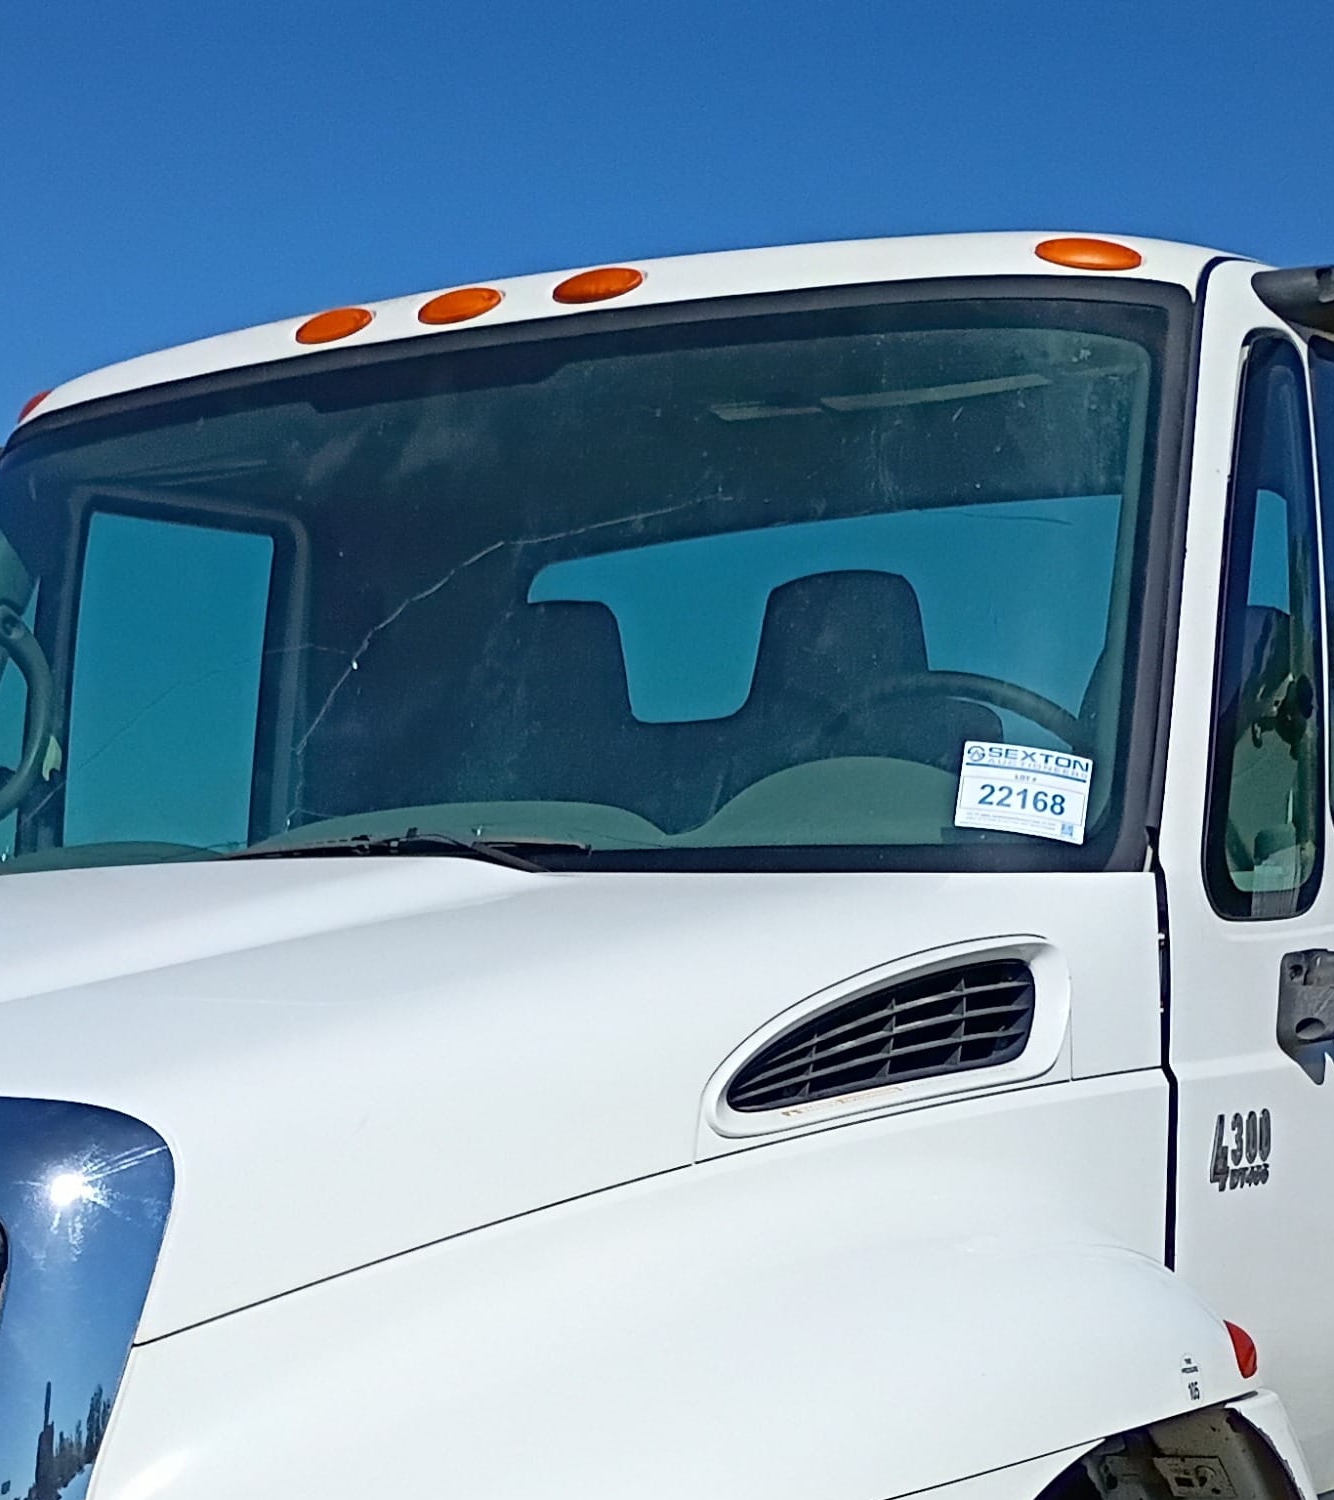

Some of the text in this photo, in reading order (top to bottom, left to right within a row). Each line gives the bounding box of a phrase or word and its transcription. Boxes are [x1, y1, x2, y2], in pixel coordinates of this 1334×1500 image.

[988, 747, 1089, 772] SEXTON
[978, 784, 1066, 815] 22168
[1210, 1108, 1271, 1192] 4300
